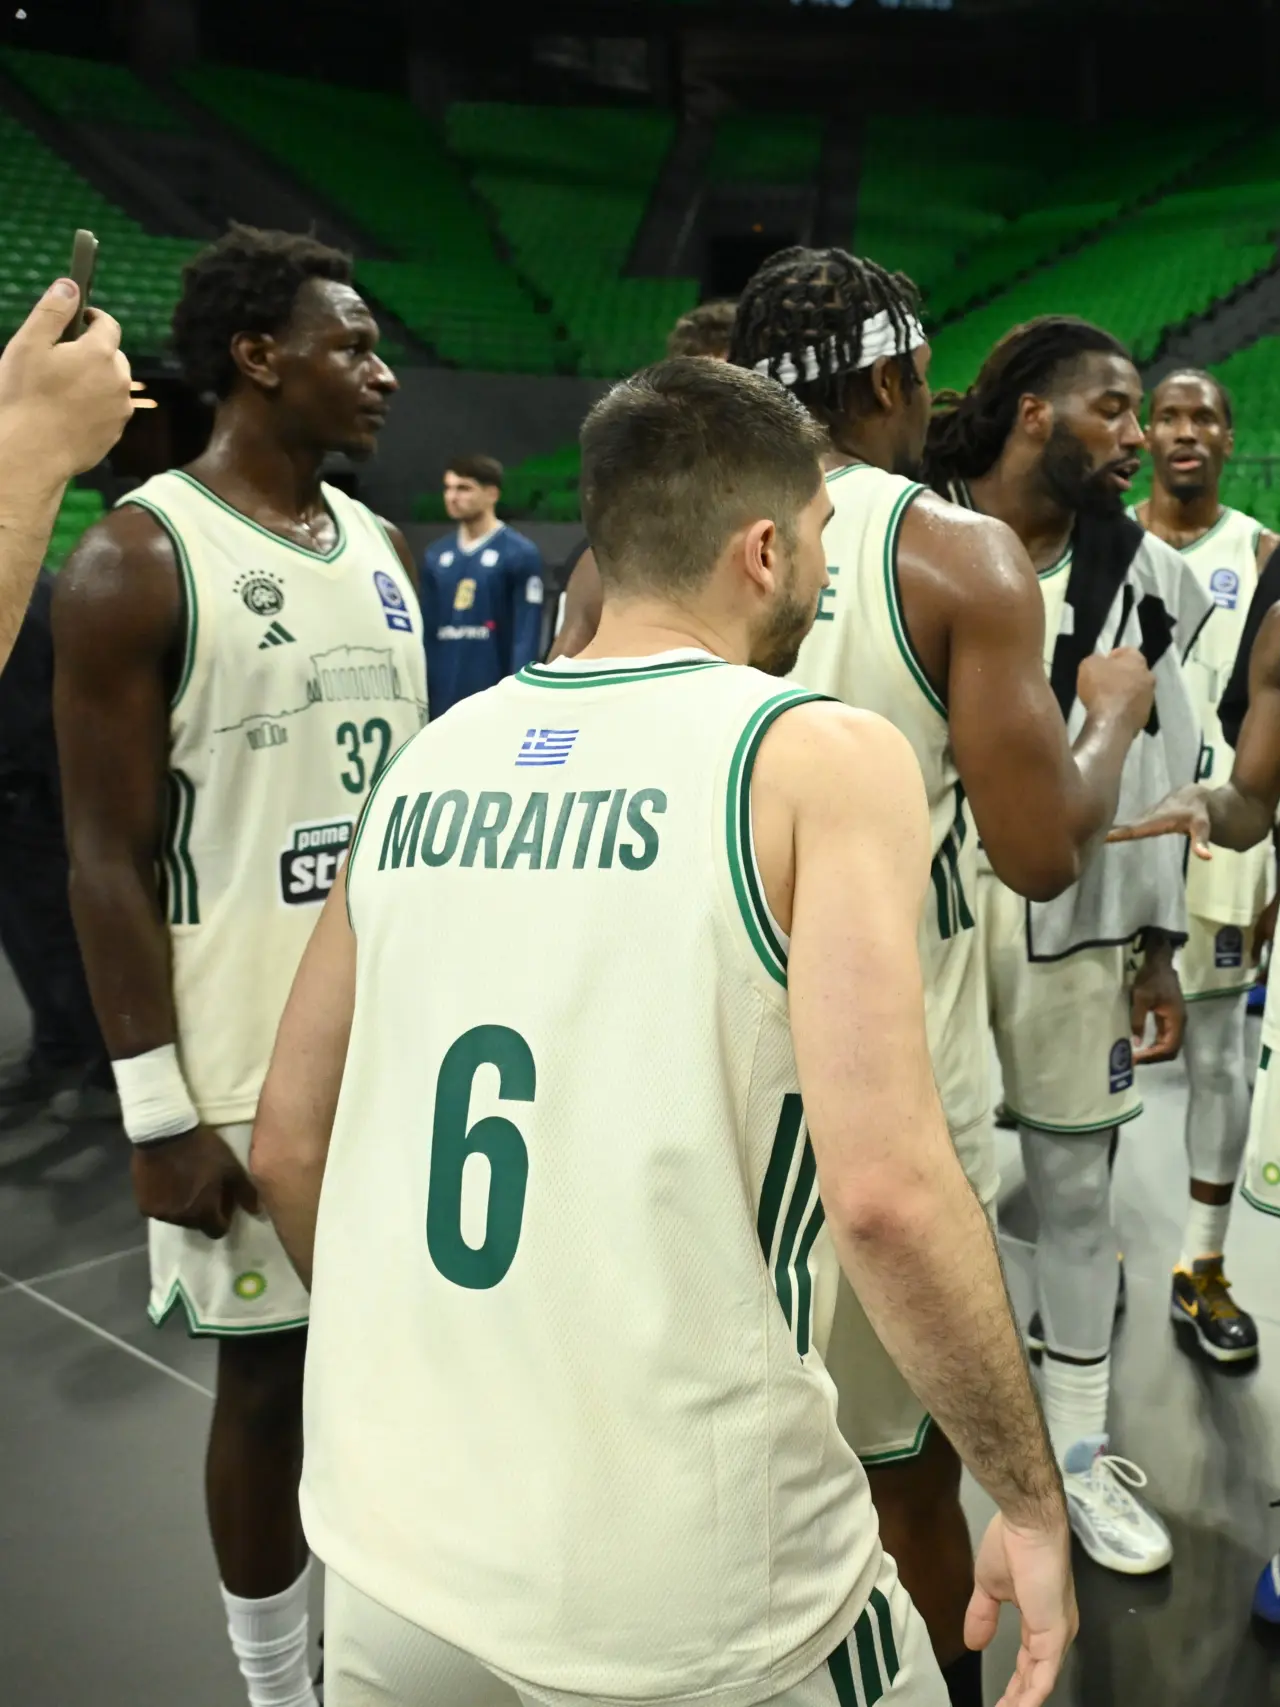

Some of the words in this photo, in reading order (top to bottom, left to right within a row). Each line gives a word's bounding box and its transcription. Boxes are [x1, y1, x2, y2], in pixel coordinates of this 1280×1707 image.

[336, 717, 392, 794] 32
[377, 787, 668, 872] MORAITIS
[426, 1023, 537, 1291] 6
